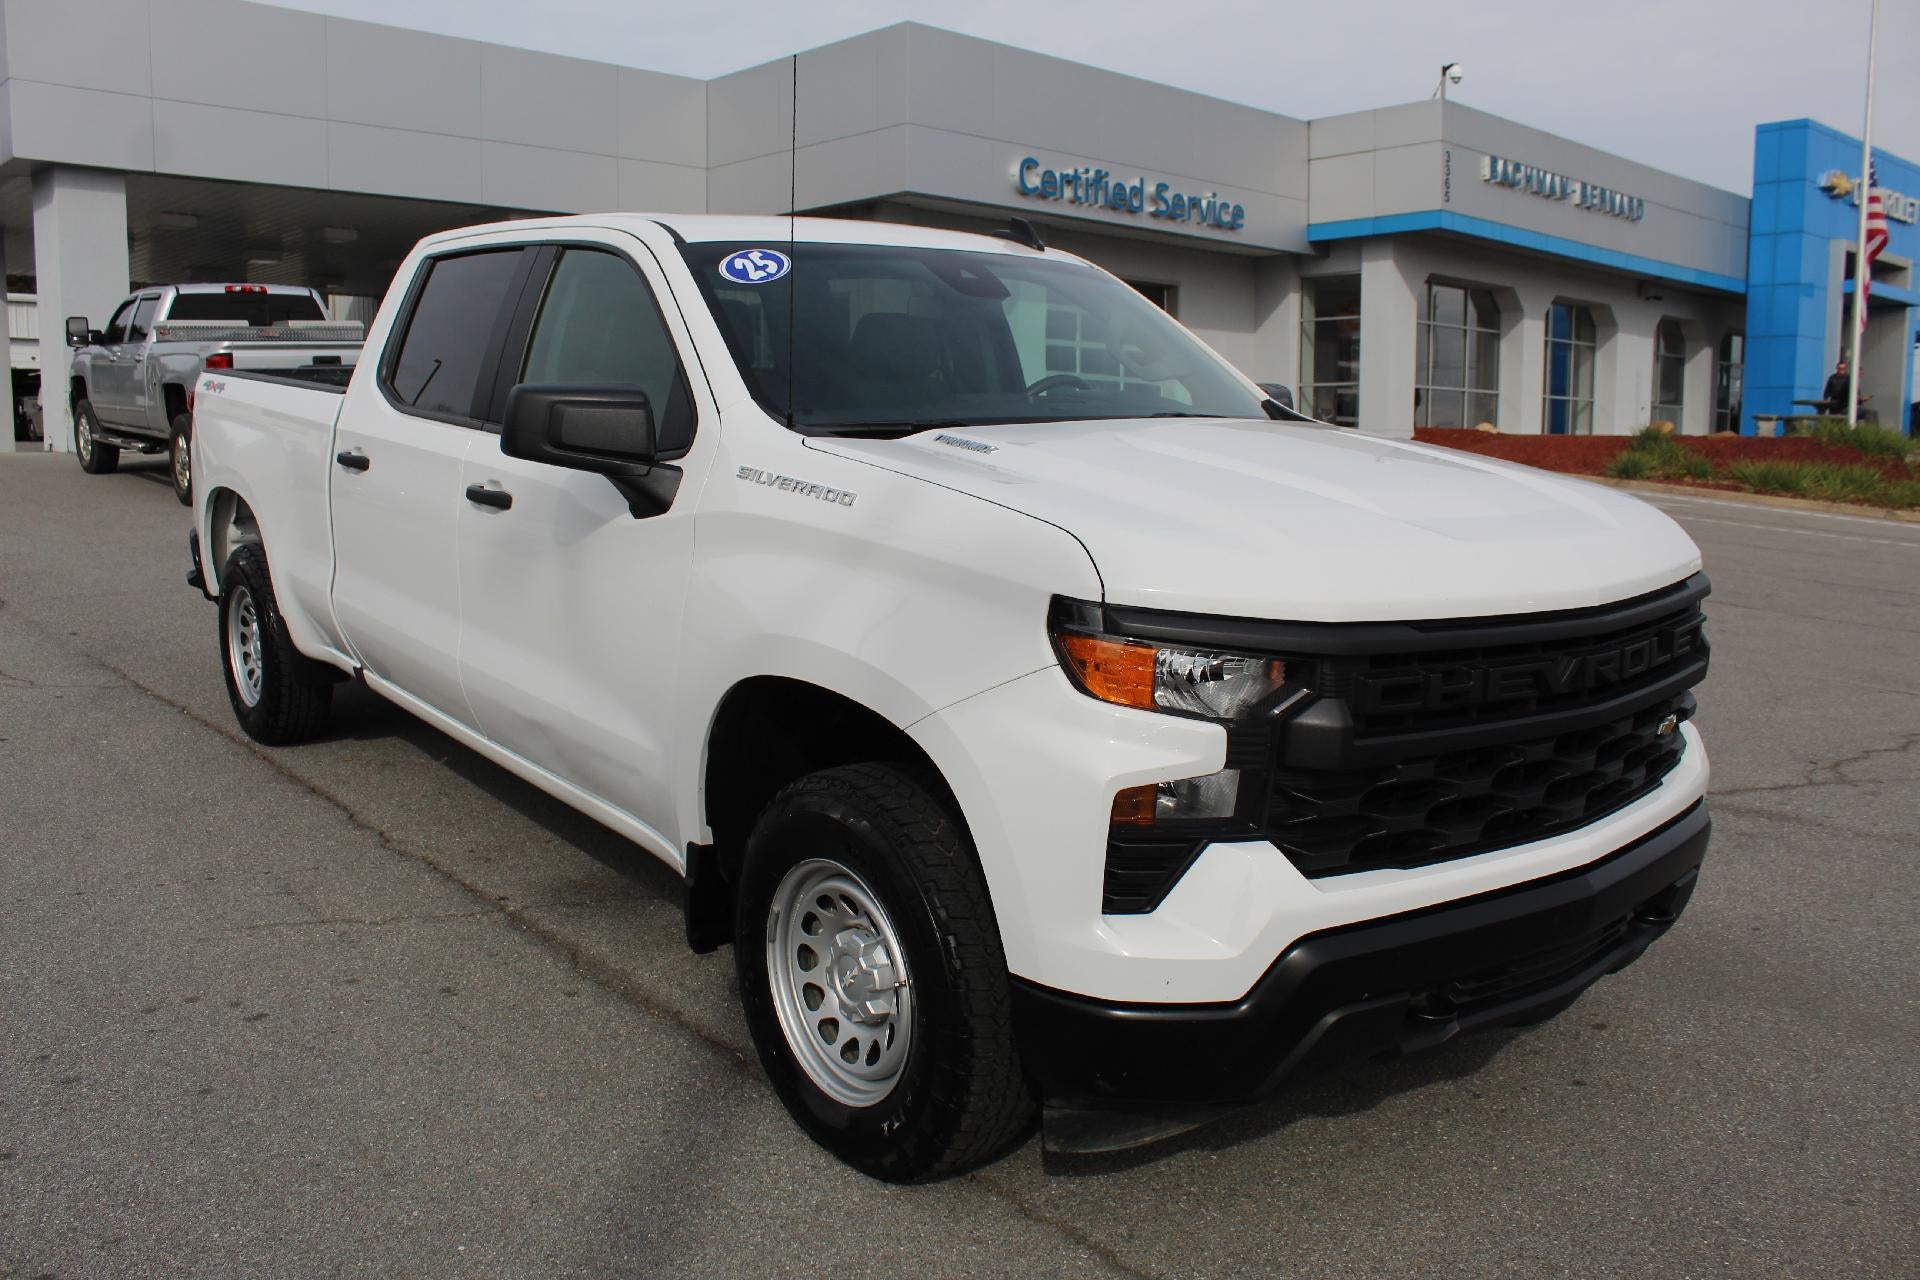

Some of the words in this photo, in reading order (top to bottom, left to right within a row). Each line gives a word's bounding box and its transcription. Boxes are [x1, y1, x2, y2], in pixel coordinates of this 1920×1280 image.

[1015, 156, 1145, 213] Certified
[1153, 182, 1245, 229] Service
[734, 251, 778, 280] 25
[736, 465, 857, 507] SILVERADO
